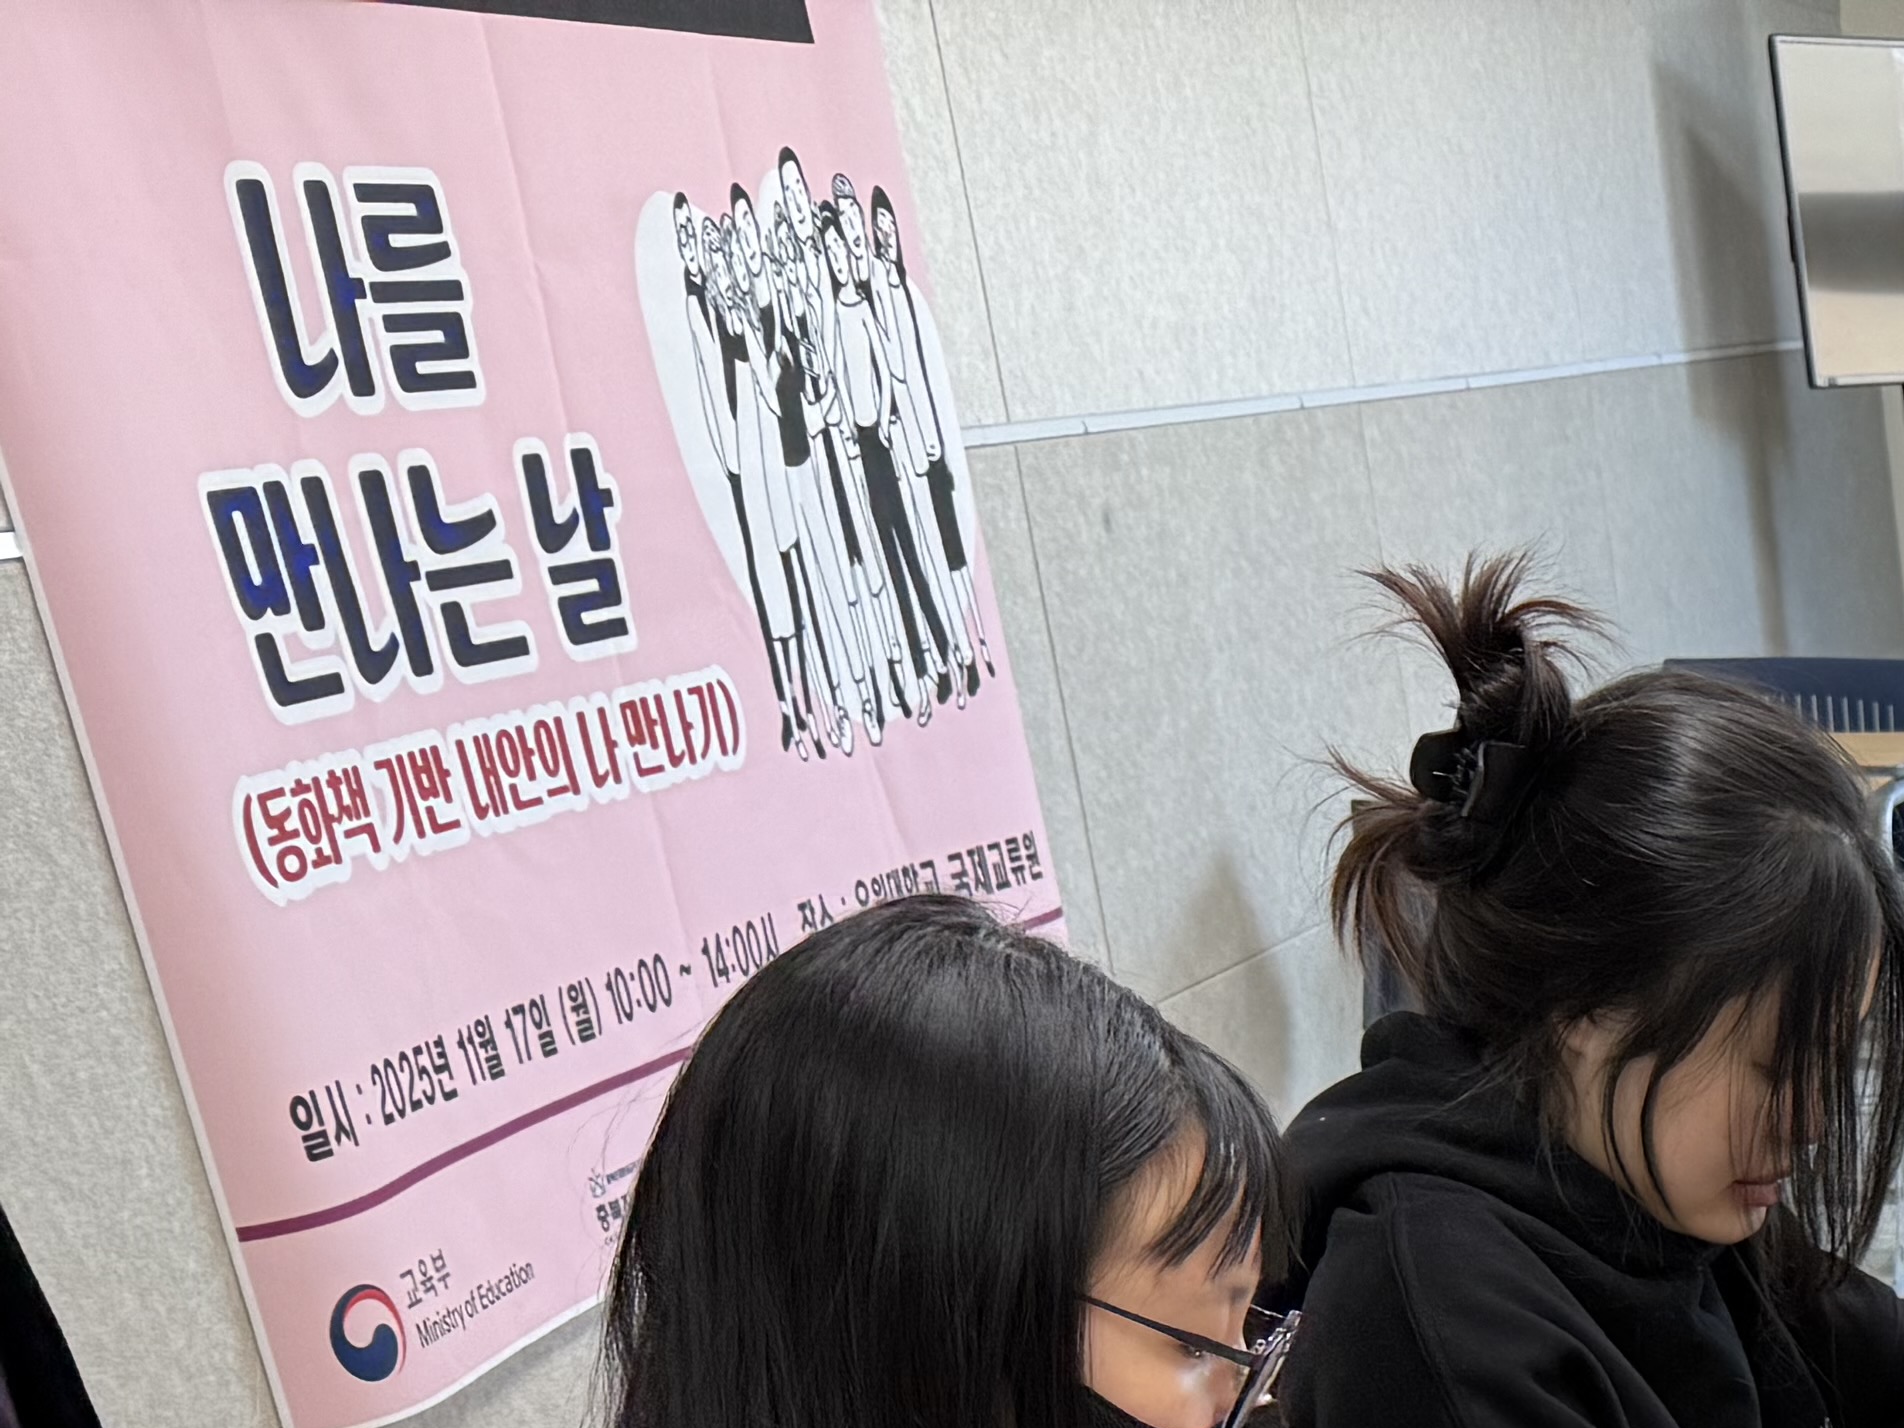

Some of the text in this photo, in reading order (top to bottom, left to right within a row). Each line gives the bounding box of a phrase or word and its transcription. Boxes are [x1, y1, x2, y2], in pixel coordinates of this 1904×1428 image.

[234, 178, 477, 400] 나를
[206, 446, 629, 709] 만나는 날
[243, 678, 740, 888] (동화책 기반 내안의 나 만나기)
[947, 829, 1043, 898] 국제교류원
[289, 1080, 359, 1162] 일시
[370, 1034, 458, 1126] 2025년
[457, 1014, 506, 1086] 11월
[504, 993, 559, 1065] 17일
[558, 976, 602, 1046] (월)
[605, 953, 673, 1024] 10:00
[701, 911, 780, 988] 14:00시
[399, 1249, 451, 1310] 교육부
[415, 1260, 536, 1349] Ministry of Education
